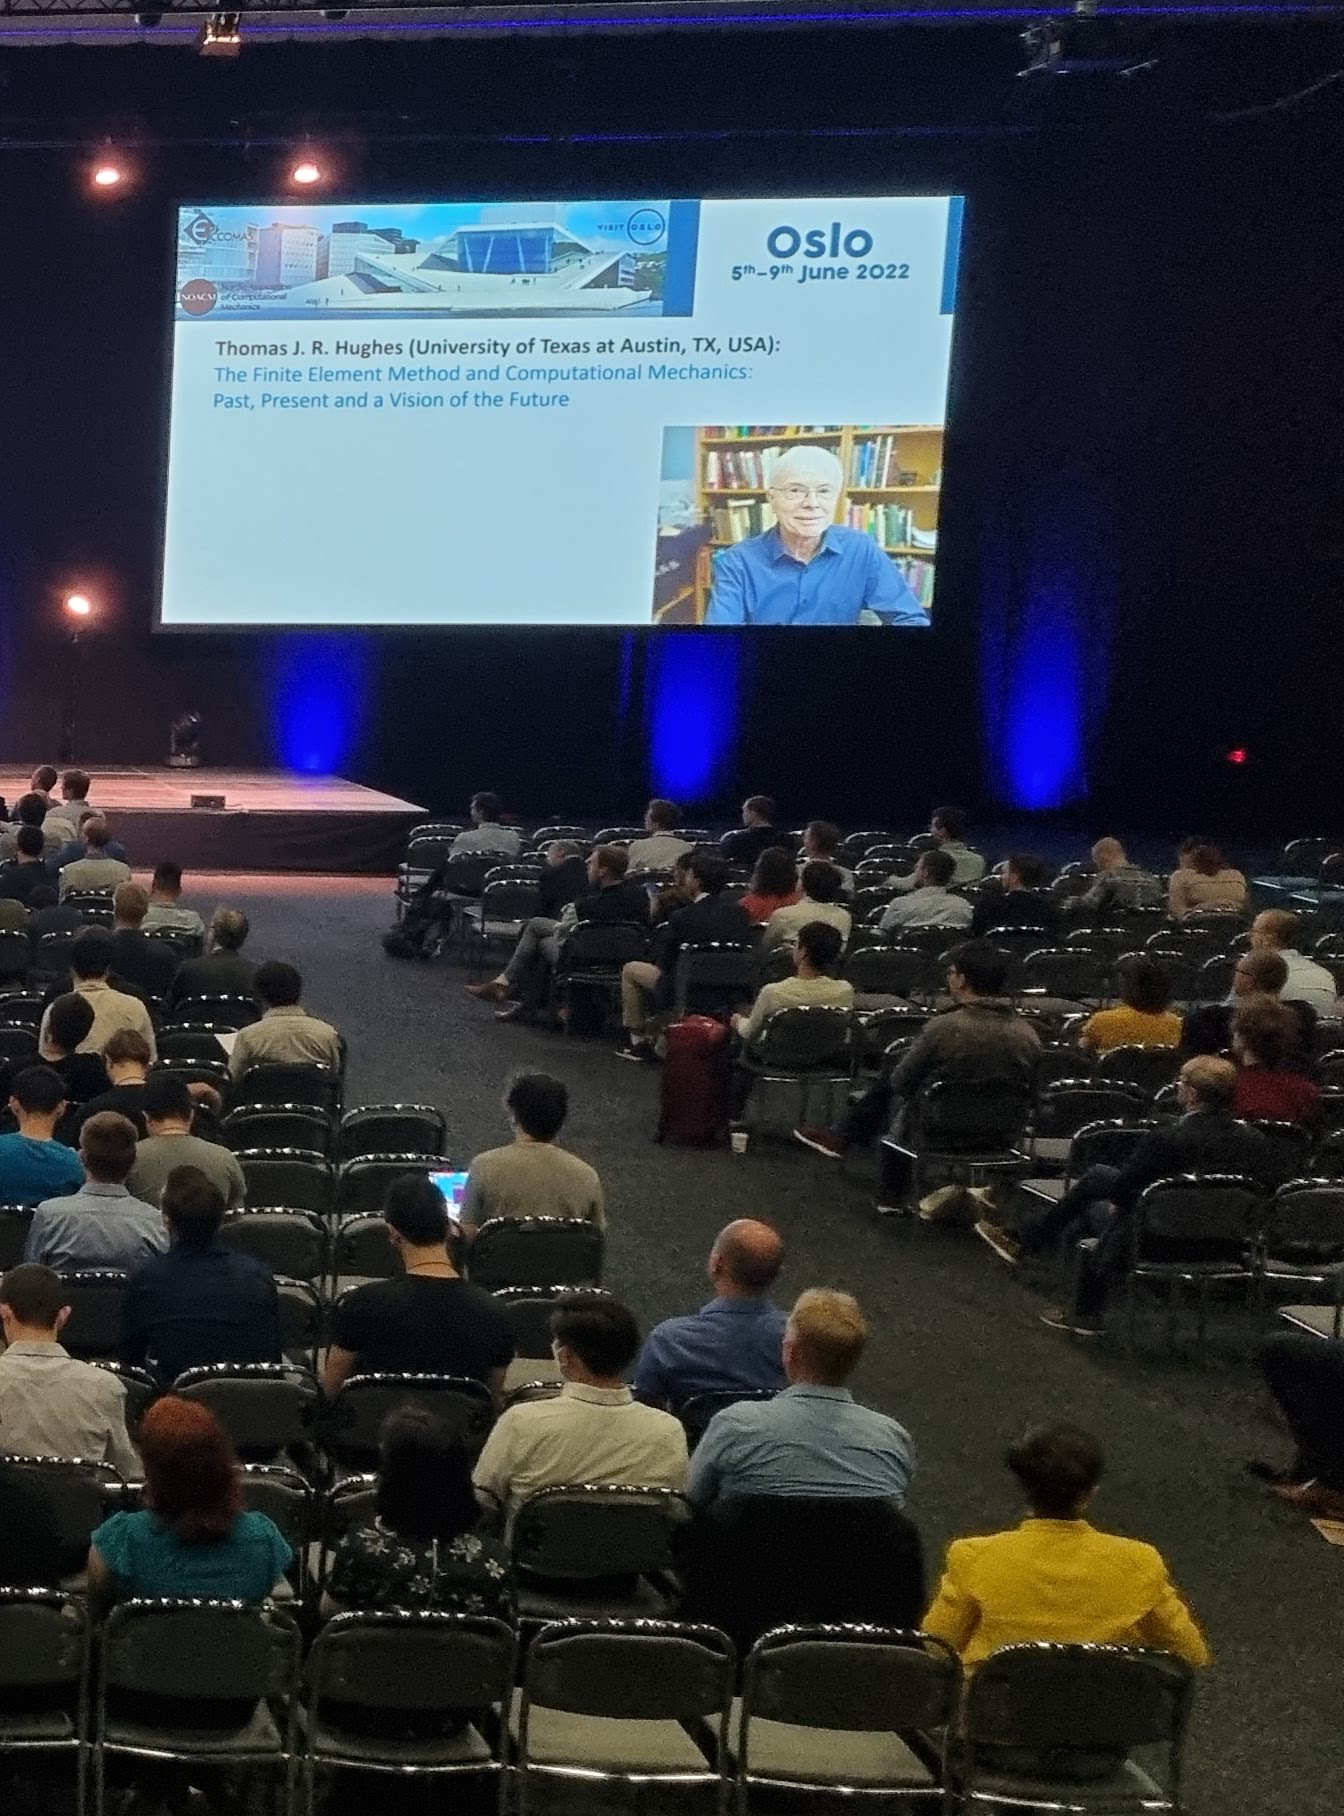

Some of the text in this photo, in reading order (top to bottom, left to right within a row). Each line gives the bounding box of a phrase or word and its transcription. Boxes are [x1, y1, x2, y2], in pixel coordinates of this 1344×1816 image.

[597, 223, 662, 231] VISIT OSLO
[768, 223, 873, 258] Oslo
[797, 265, 849, 284] June
[856, 264, 909, 279] 2022
[216, 335, 780, 358] Thomas J. R. Hughes (University of Texas at Austin, TX, USA):
[215, 364, 752, 384] The Finite Element Method and Computational Mechanics:
[214, 391, 569, 410] Past, Present and a Vision of the Future
